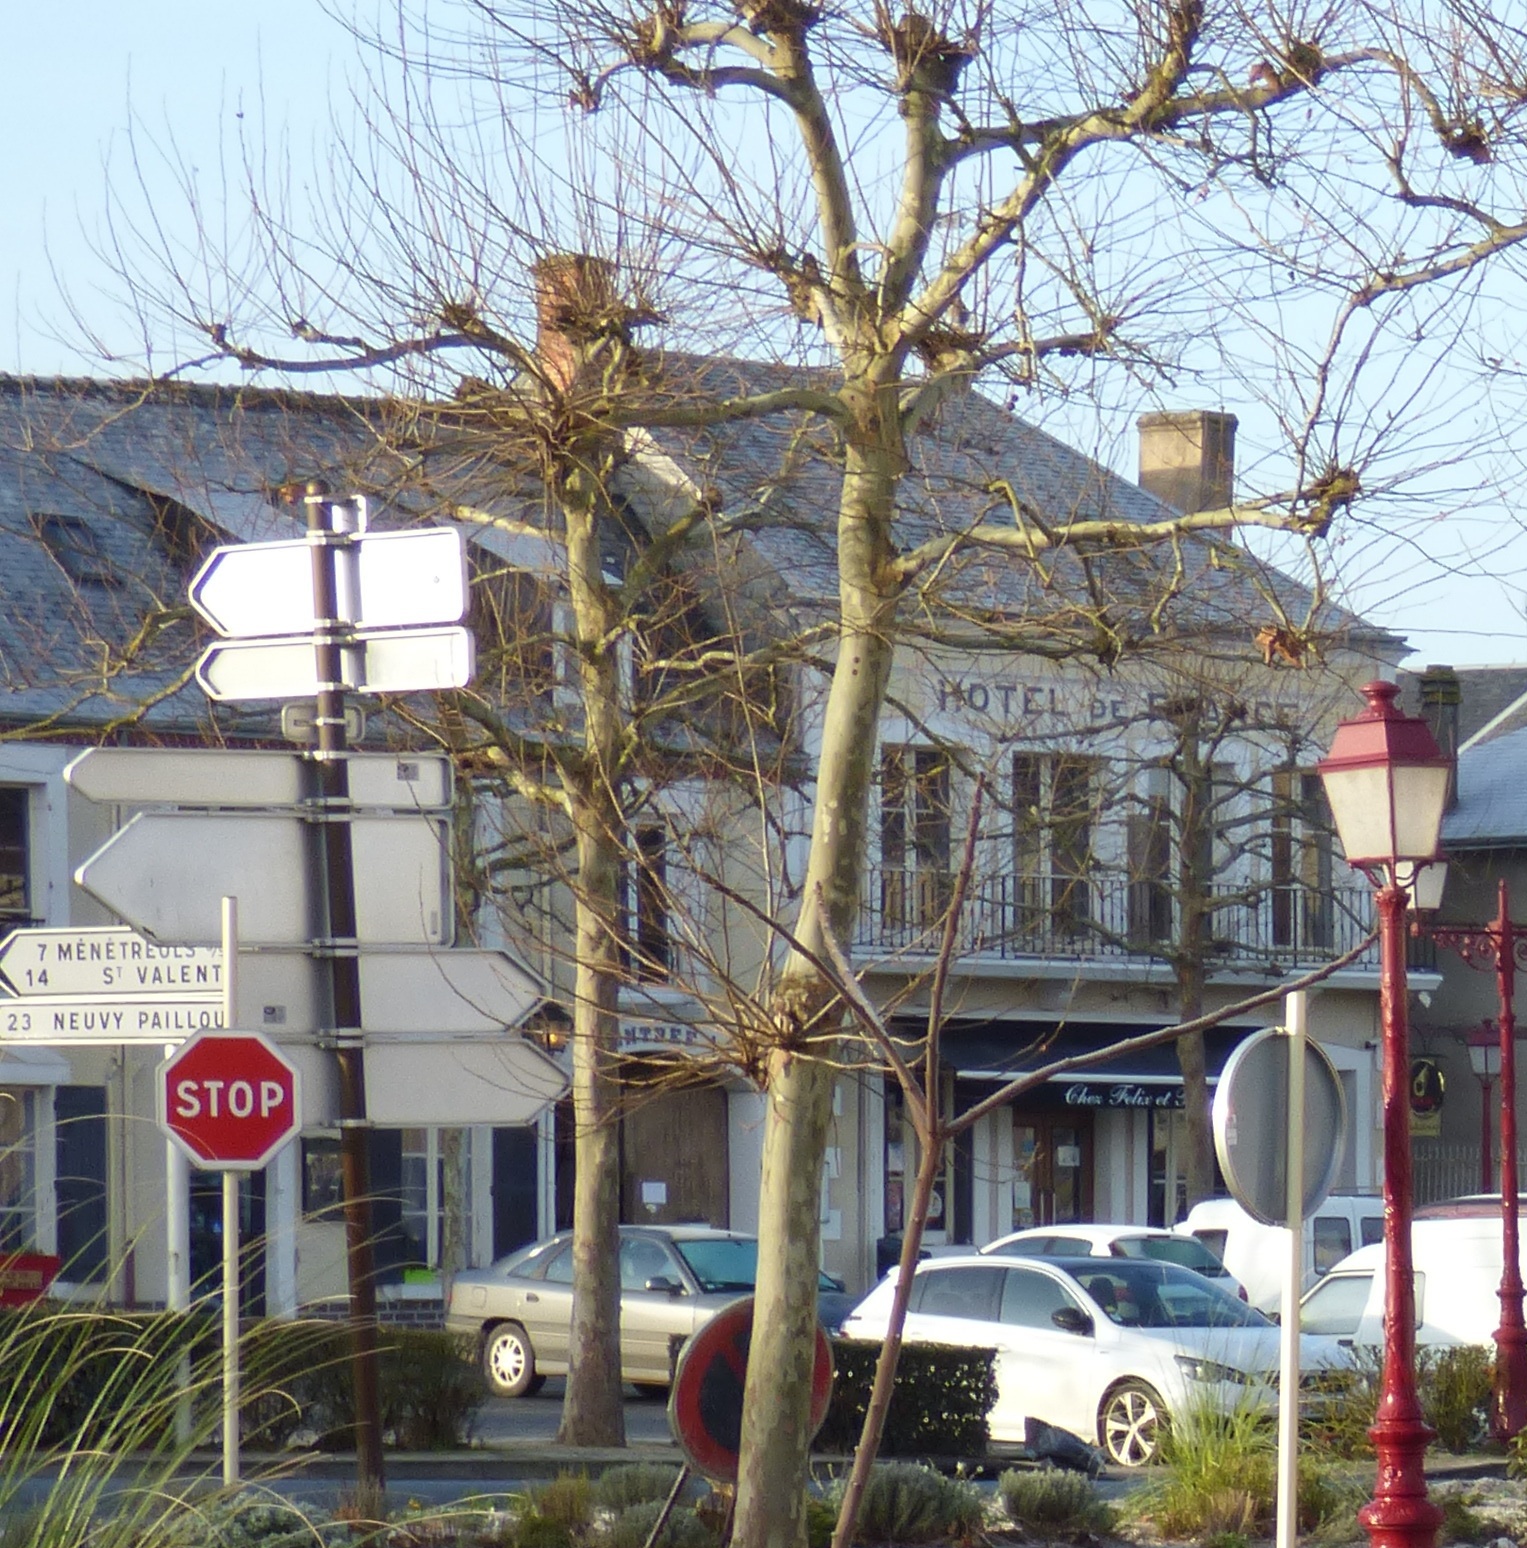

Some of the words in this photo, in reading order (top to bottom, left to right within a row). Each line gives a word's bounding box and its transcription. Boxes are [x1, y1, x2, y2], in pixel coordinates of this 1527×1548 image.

[38, 944, 47, 961] 7
[26, 968, 49, 987] 14
[7, 1013, 32, 1031] 23
[54, 1012, 124, 1030] NEUVY
[176, 1080, 284, 1118] STOP
[1065, 1084, 1101, 1106] Chez
